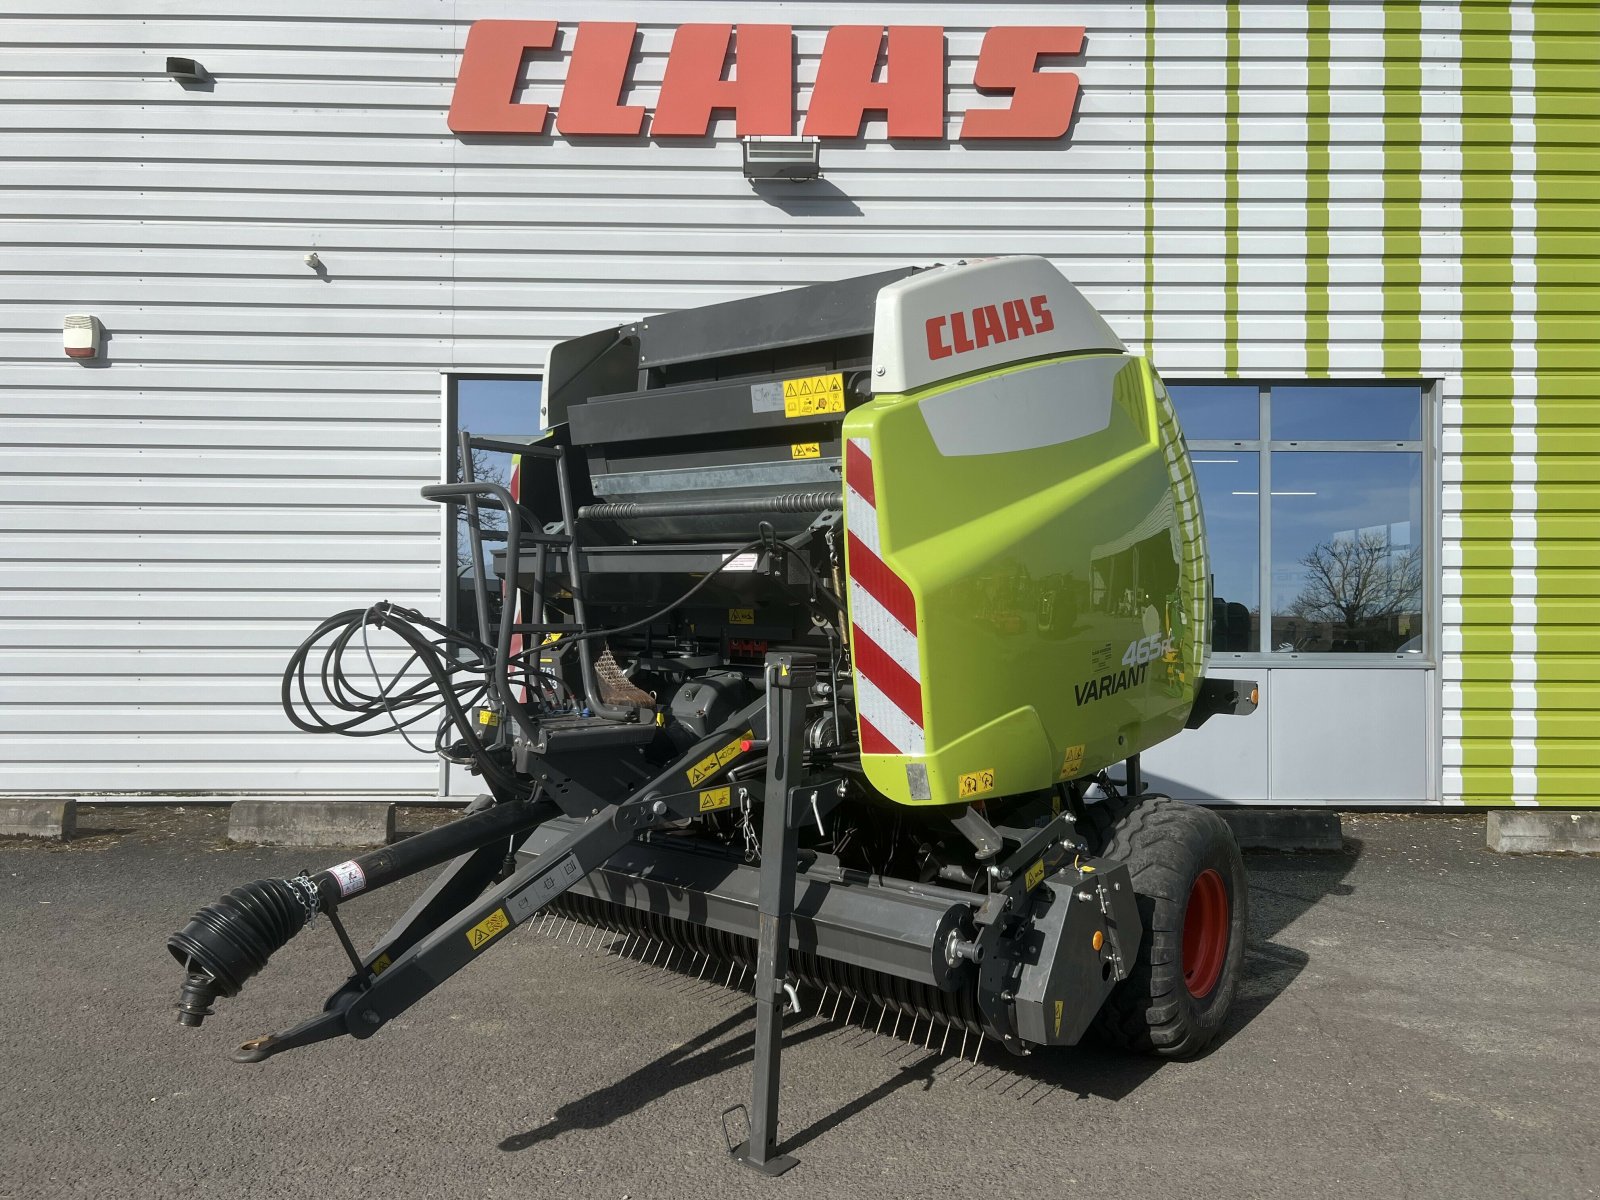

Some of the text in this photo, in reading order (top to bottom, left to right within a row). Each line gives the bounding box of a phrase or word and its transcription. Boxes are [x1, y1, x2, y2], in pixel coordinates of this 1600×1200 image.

[447, 19, 1086, 138] CLAAS
[925, 294, 1055, 360] CLAAS
[1074, 661, 1149, 707] VARIANT
